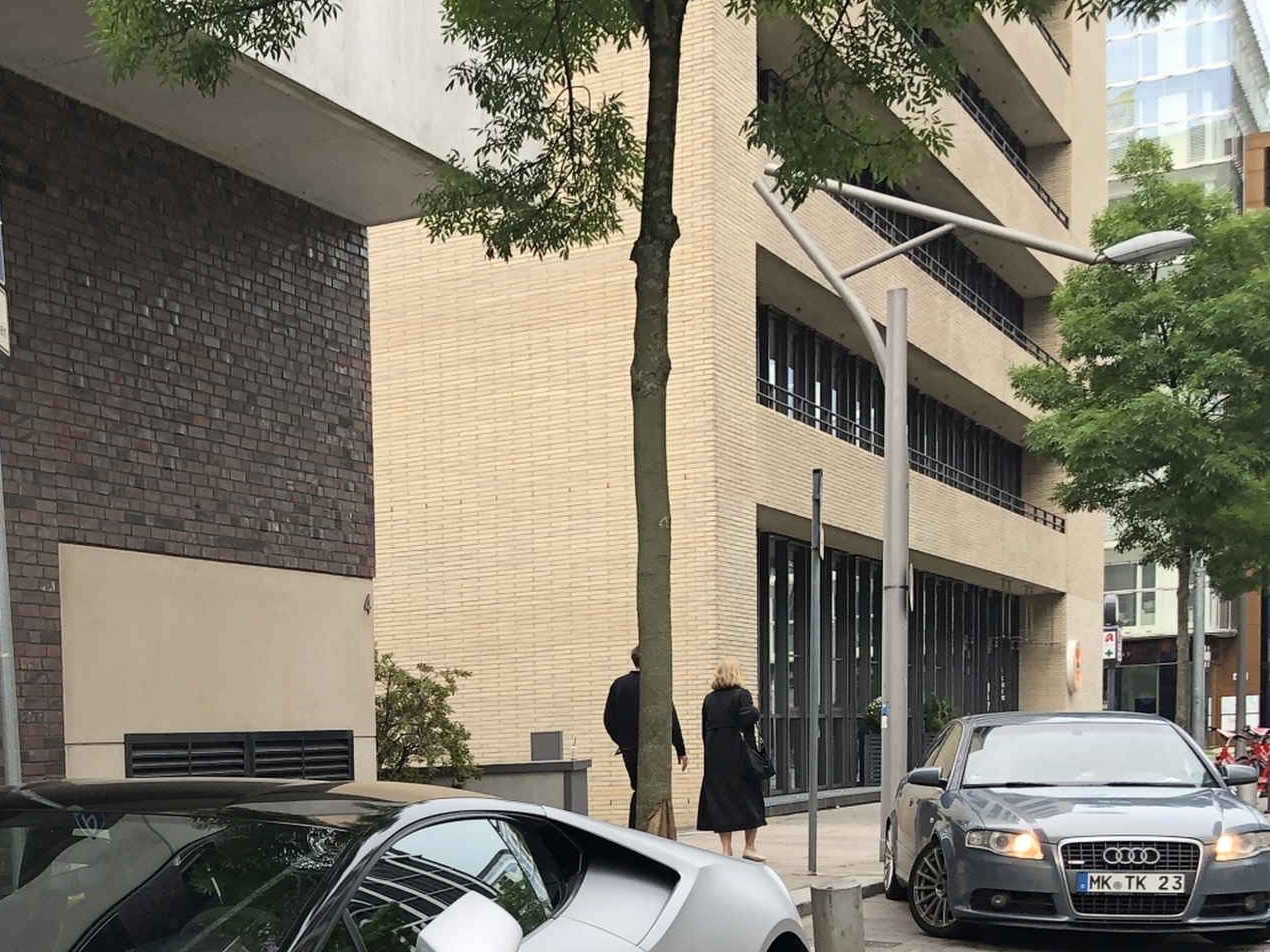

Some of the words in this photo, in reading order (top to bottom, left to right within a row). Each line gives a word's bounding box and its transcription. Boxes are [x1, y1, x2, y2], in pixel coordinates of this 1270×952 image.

[363, 594, 371, 615] 4
[1089, 875, 1113, 890] MK
[1125, 875, 1147, 890] TK
[1158, 875, 1183, 890] 23
